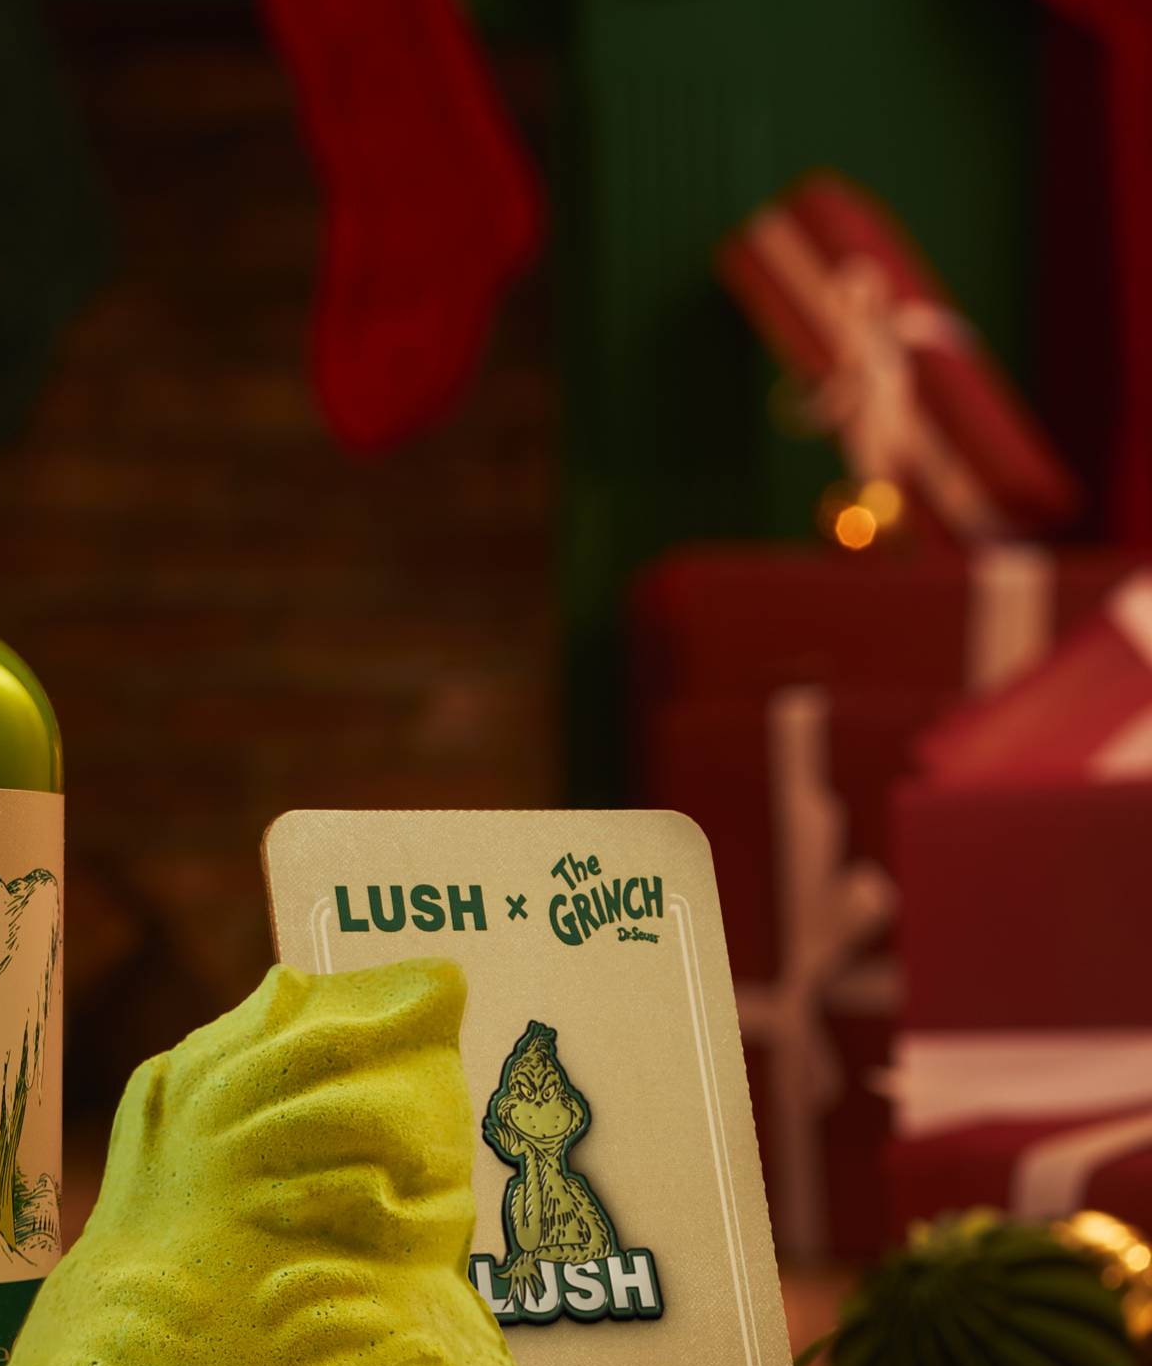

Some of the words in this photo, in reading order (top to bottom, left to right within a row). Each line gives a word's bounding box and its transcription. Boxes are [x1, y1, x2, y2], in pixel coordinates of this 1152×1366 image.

[550, 851, 602, 891] The
[334, 883, 488, 932] LUSH
[548, 874, 664, 947] GRINCH
[474, 1254, 657, 1315] LUSH
